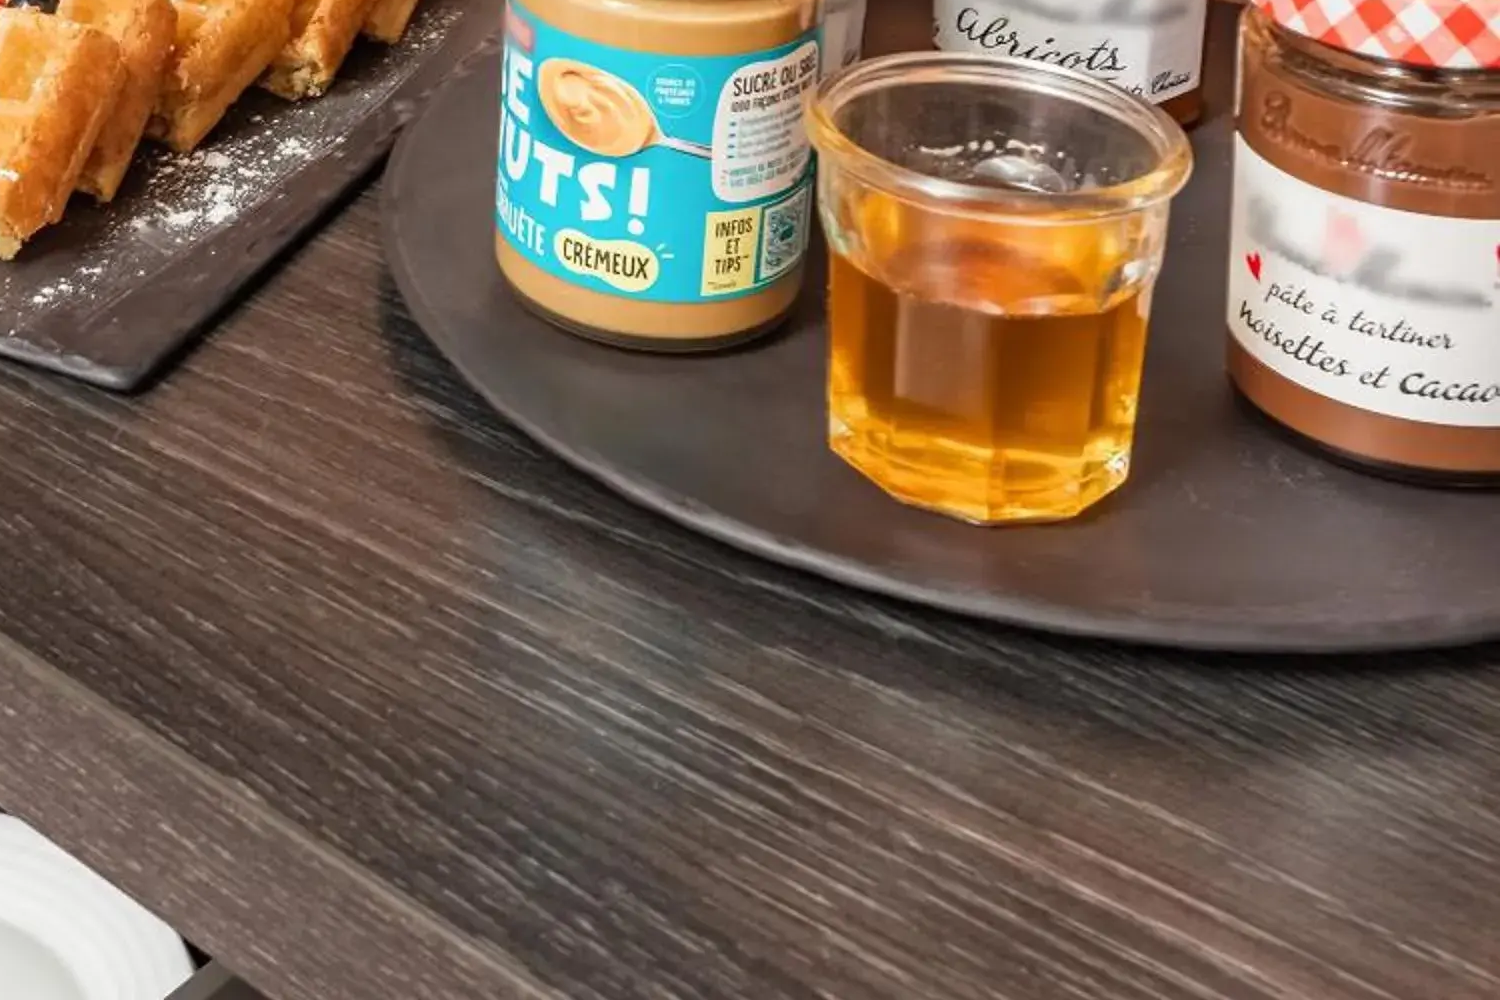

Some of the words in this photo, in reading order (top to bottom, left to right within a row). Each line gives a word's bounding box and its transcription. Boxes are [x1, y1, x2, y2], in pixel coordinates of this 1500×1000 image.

[502, 42, 533, 125] E
[733, 67, 777, 97] SUCRÉ
[499, 104, 650, 236] UTS!
[715, 217, 753, 239] INFOS
[562, 237, 650, 280] CRÉMEUX
[725, 238, 741, 255] ET
[1264, 282, 1313, 315] pâte
[1321, 302, 1340, 325] à
[1348, 309, 1458, 350] tartiner
[1359, 364, 1391, 390] et
